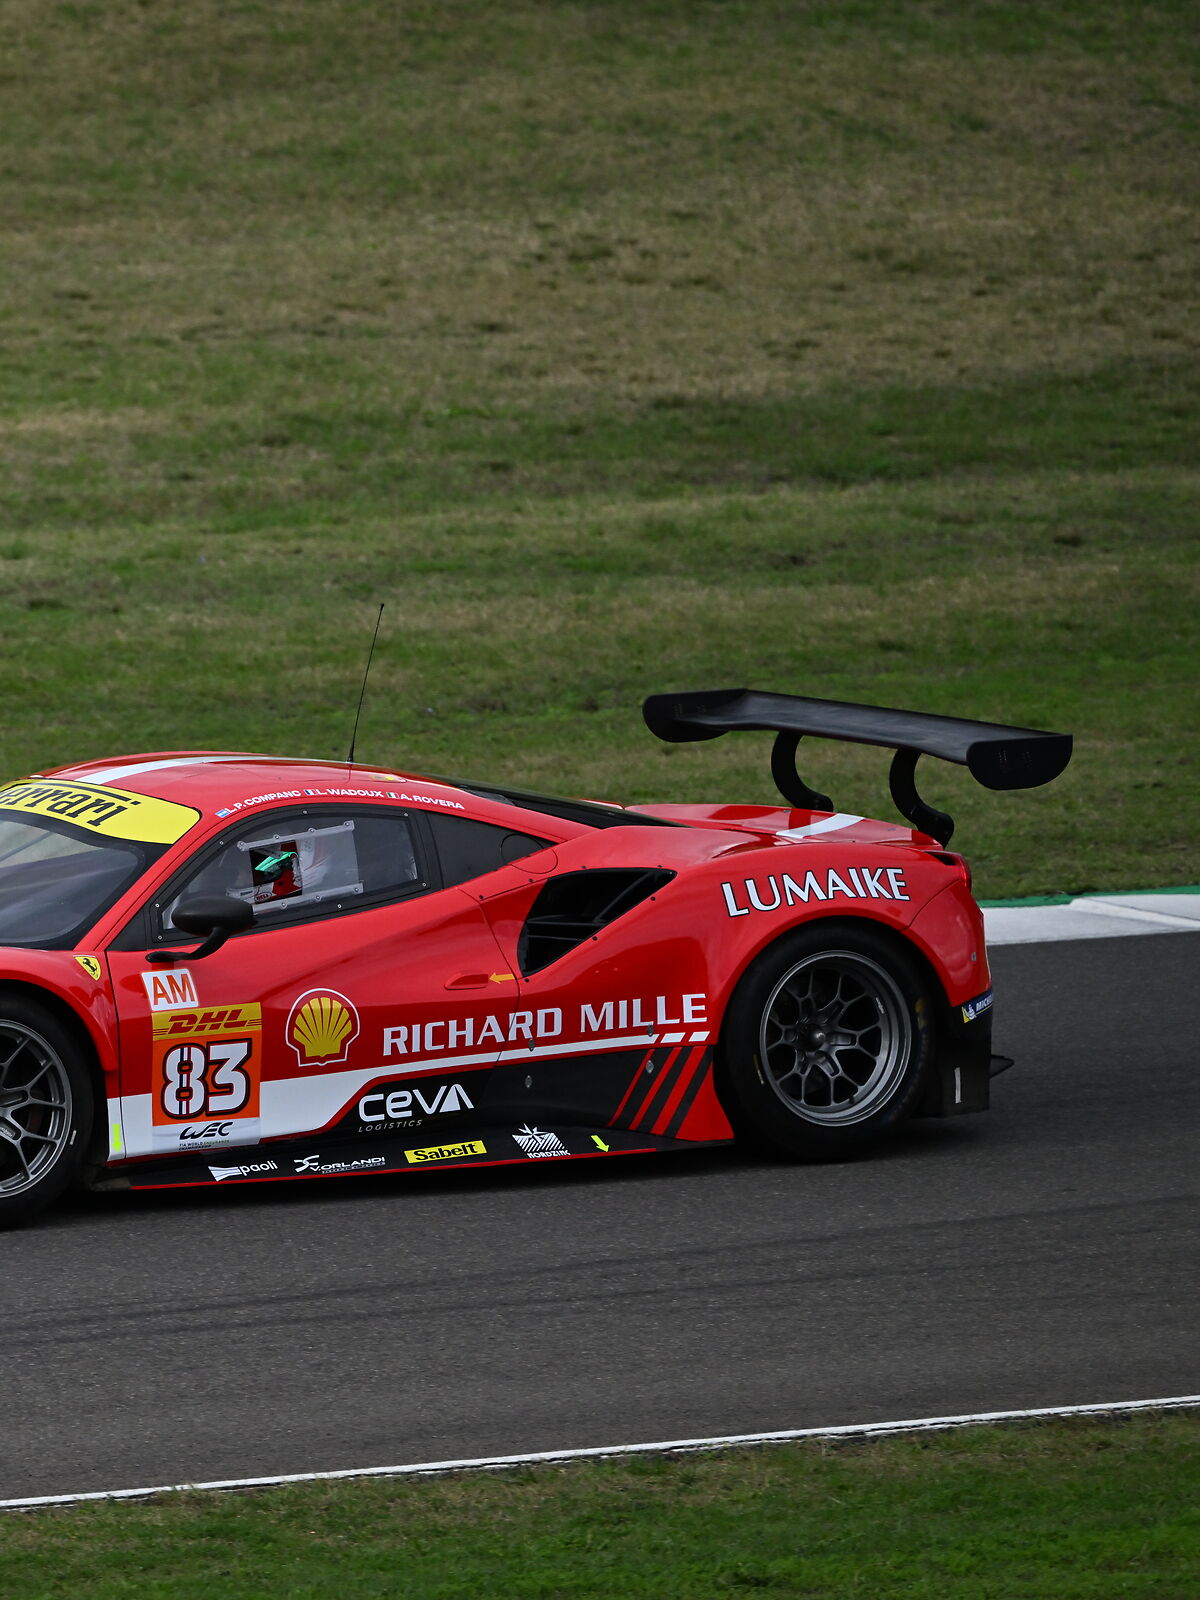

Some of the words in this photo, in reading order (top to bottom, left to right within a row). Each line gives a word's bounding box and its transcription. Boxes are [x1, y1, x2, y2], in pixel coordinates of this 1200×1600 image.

[721, 867, 911, 917] LUMAIKE
[152, 973, 196, 1006] AM
[167, 1009, 248, 1035] DHL
[383, 1007, 562, 1056] RICHARD
[580, 993, 708, 1033] MILLE
[161, 1038, 252, 1120] 83
[179, 1121, 234, 1140] WEC
[358, 1119, 423, 1133] LOGISTICS
[413, 1142, 479, 1163] Sabelt
[240, 1160, 279, 1177] paoli
